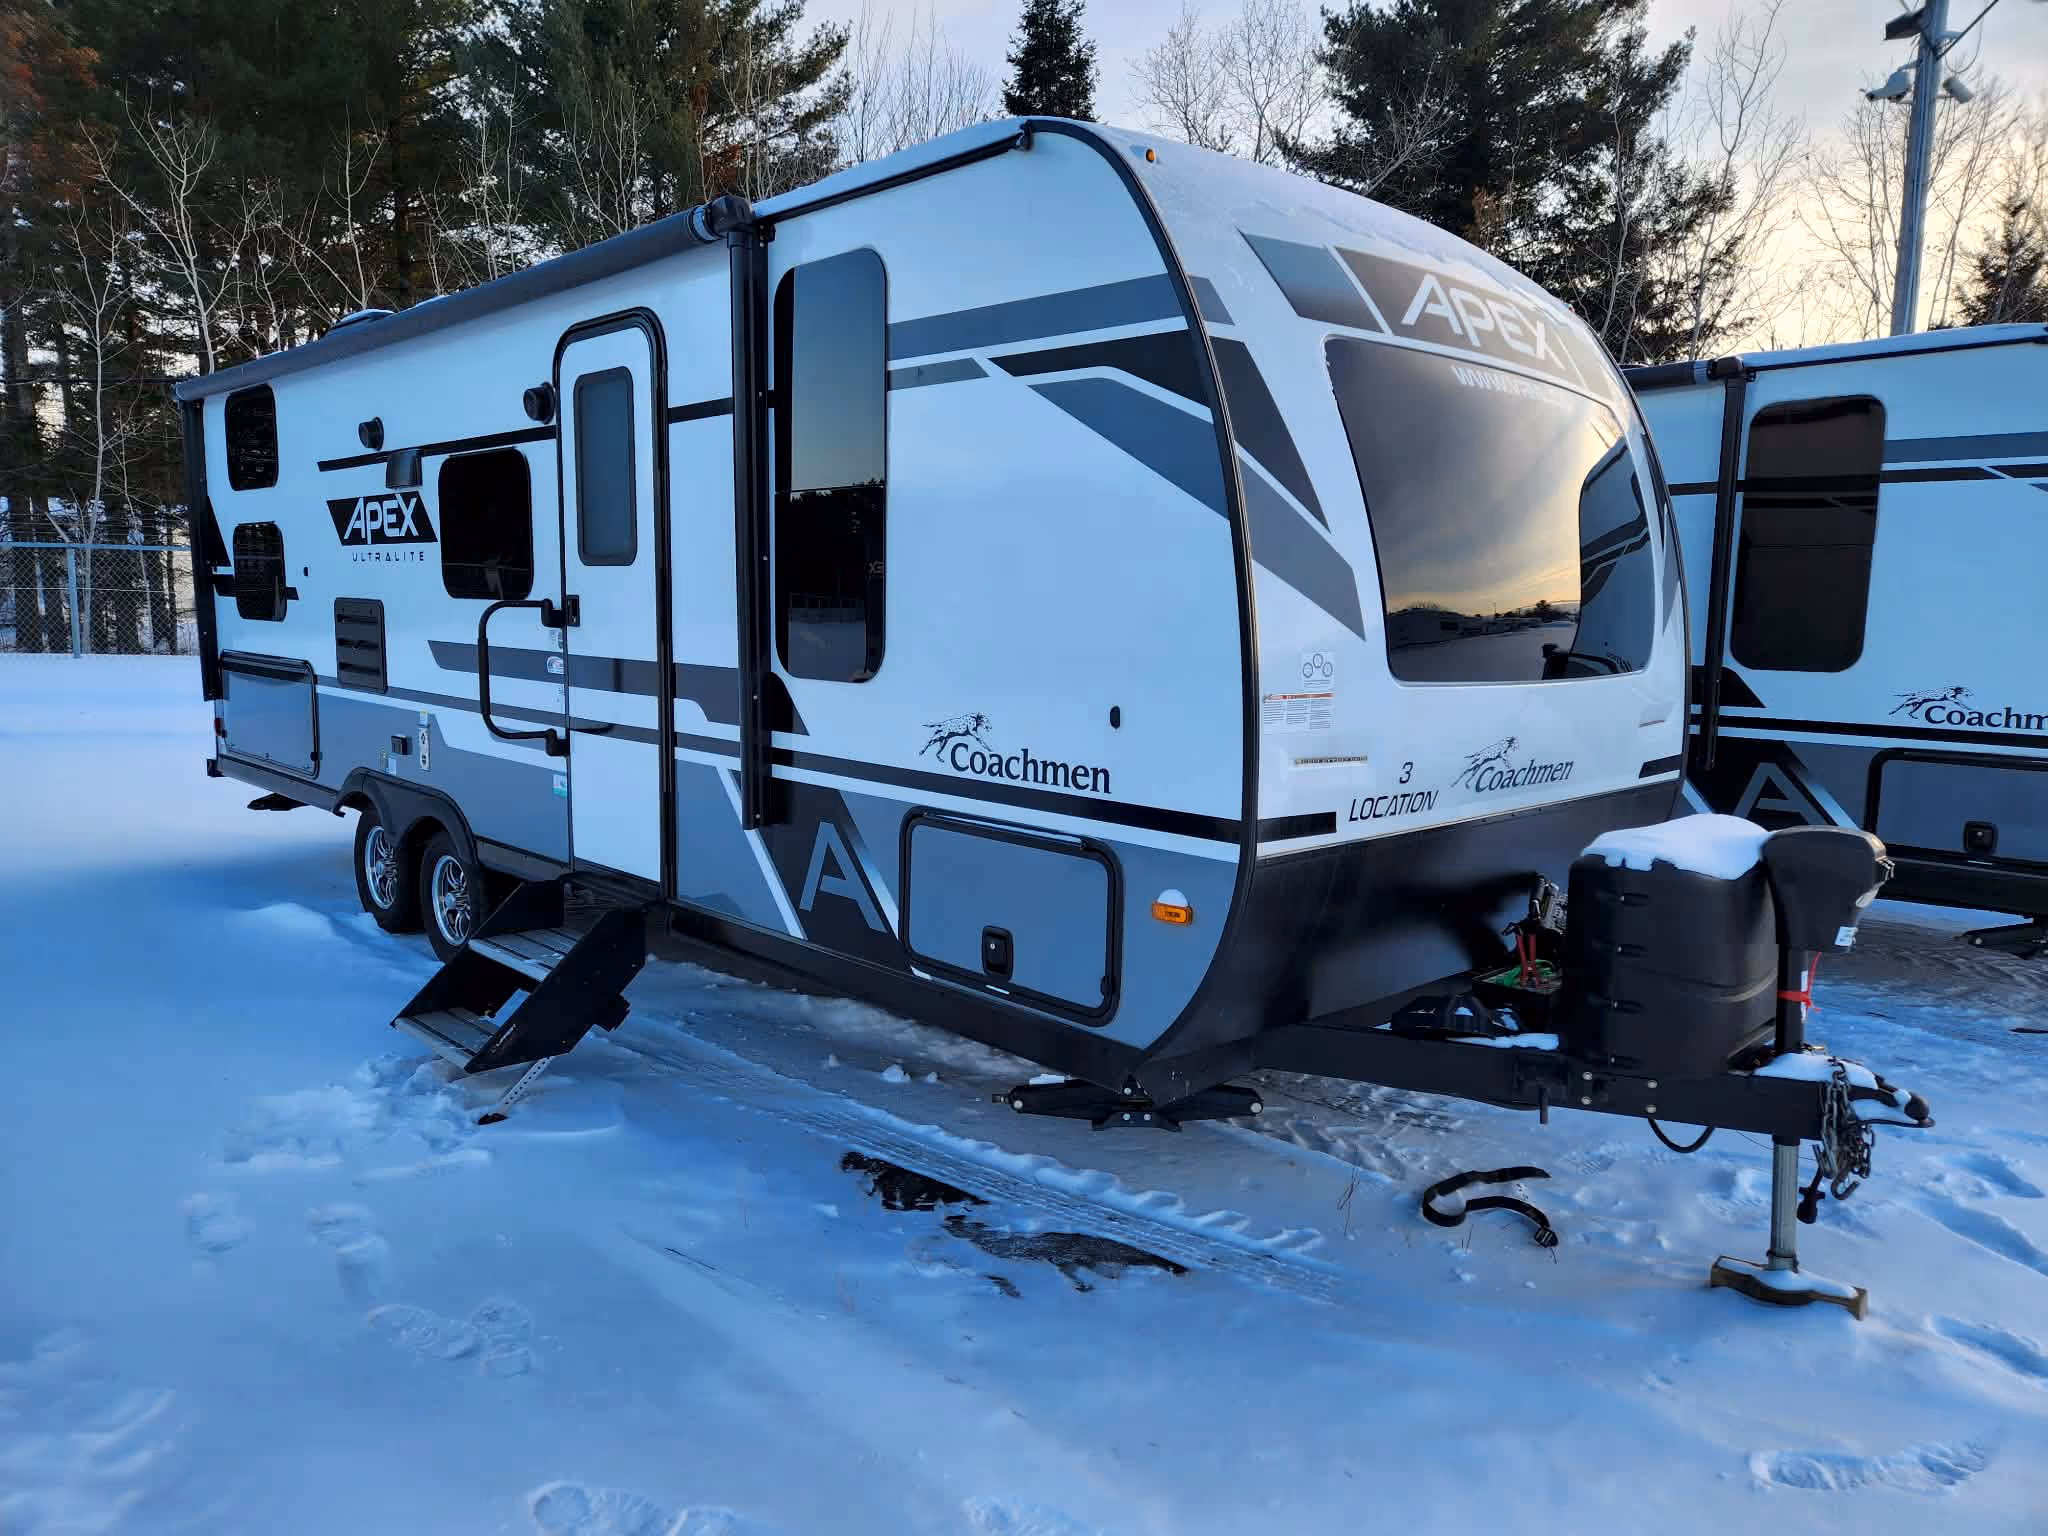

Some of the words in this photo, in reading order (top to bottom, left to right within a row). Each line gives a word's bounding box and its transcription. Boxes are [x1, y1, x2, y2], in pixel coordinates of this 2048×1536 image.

[1401, 273, 1565, 369] APEX
[343, 493, 419, 545] APEX
[352, 550, 425, 563] ULTRALITE
[950, 742, 1112, 794] Coachmen
[1399, 761, 1414, 784] 3
[1475, 759, 1575, 793] Coachmen
[1349, 790, 1439, 822] LOCATION
